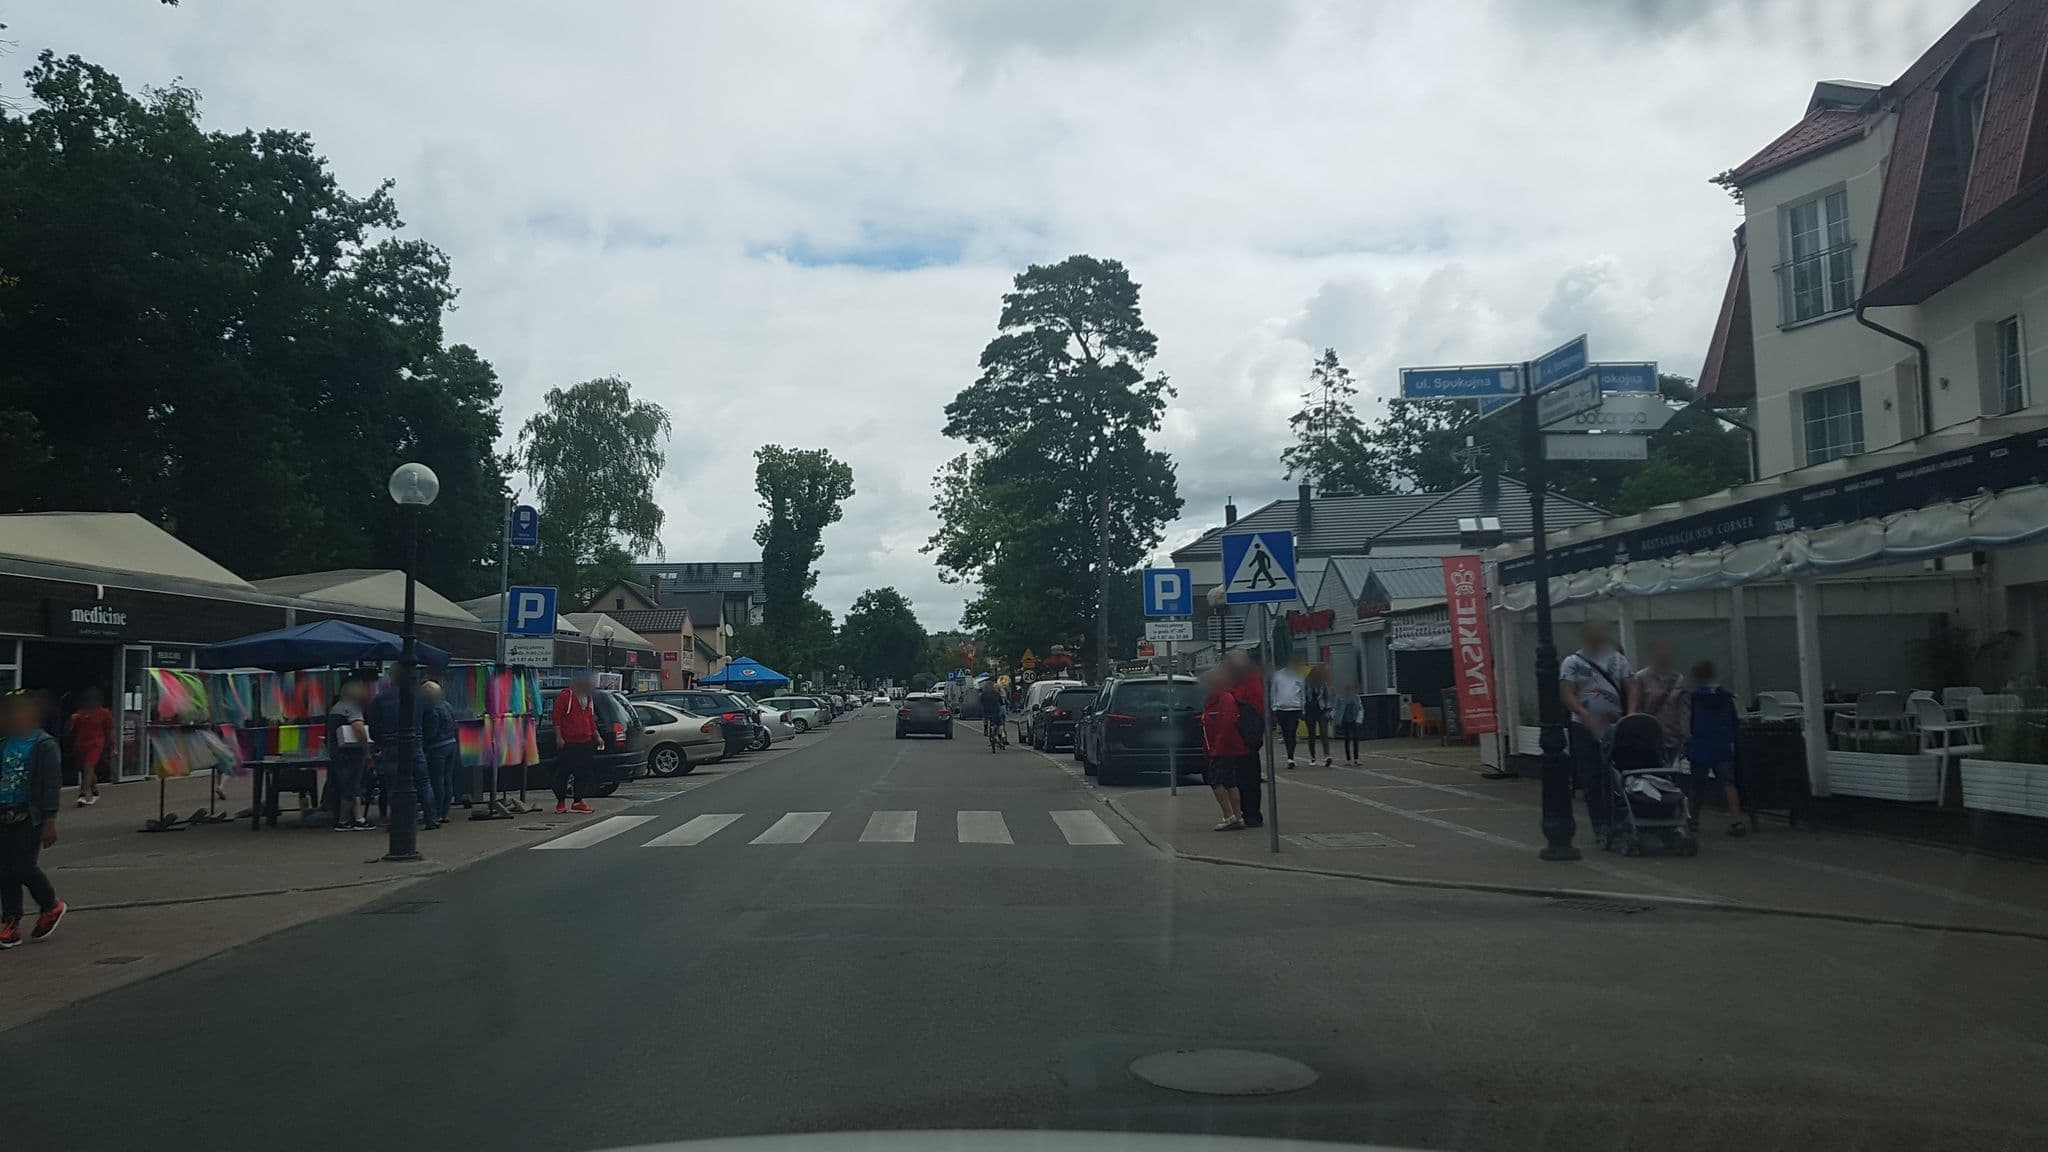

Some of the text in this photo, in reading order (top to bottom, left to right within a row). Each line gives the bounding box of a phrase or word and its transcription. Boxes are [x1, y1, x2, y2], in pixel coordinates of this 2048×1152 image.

[1415, 376, 1491, 391] ul. Spokojna
[1718, 516, 1754, 534] CORNER
[1154, 574, 1181, 610] P
[71, 605, 127, 626] medicine
[517, 592, 545, 628] P
[1024, 672, 1035, 681] 20
